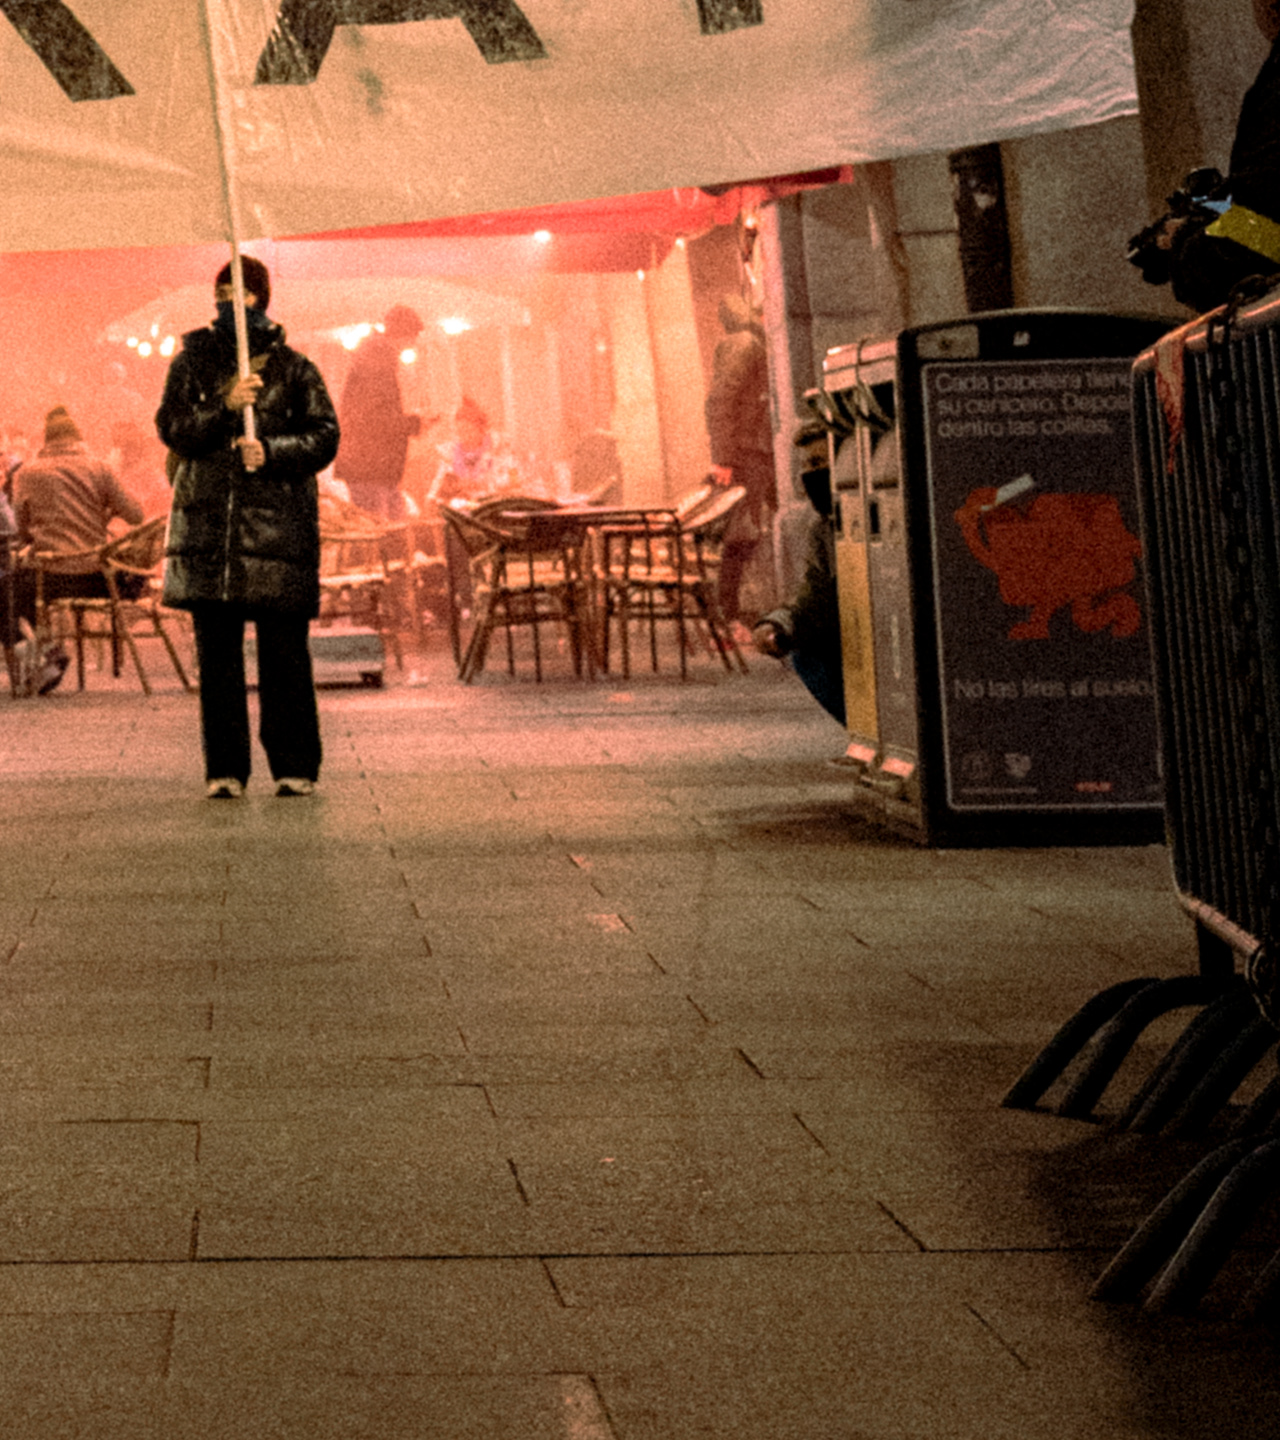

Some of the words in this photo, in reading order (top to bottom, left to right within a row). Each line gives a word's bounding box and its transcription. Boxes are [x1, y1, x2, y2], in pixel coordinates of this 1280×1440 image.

[937, 399, 961, 417] su
[937, 419, 1004, 438] dentro
[1007, 418, 1037, 436] las
[953, 677, 985, 700] No
